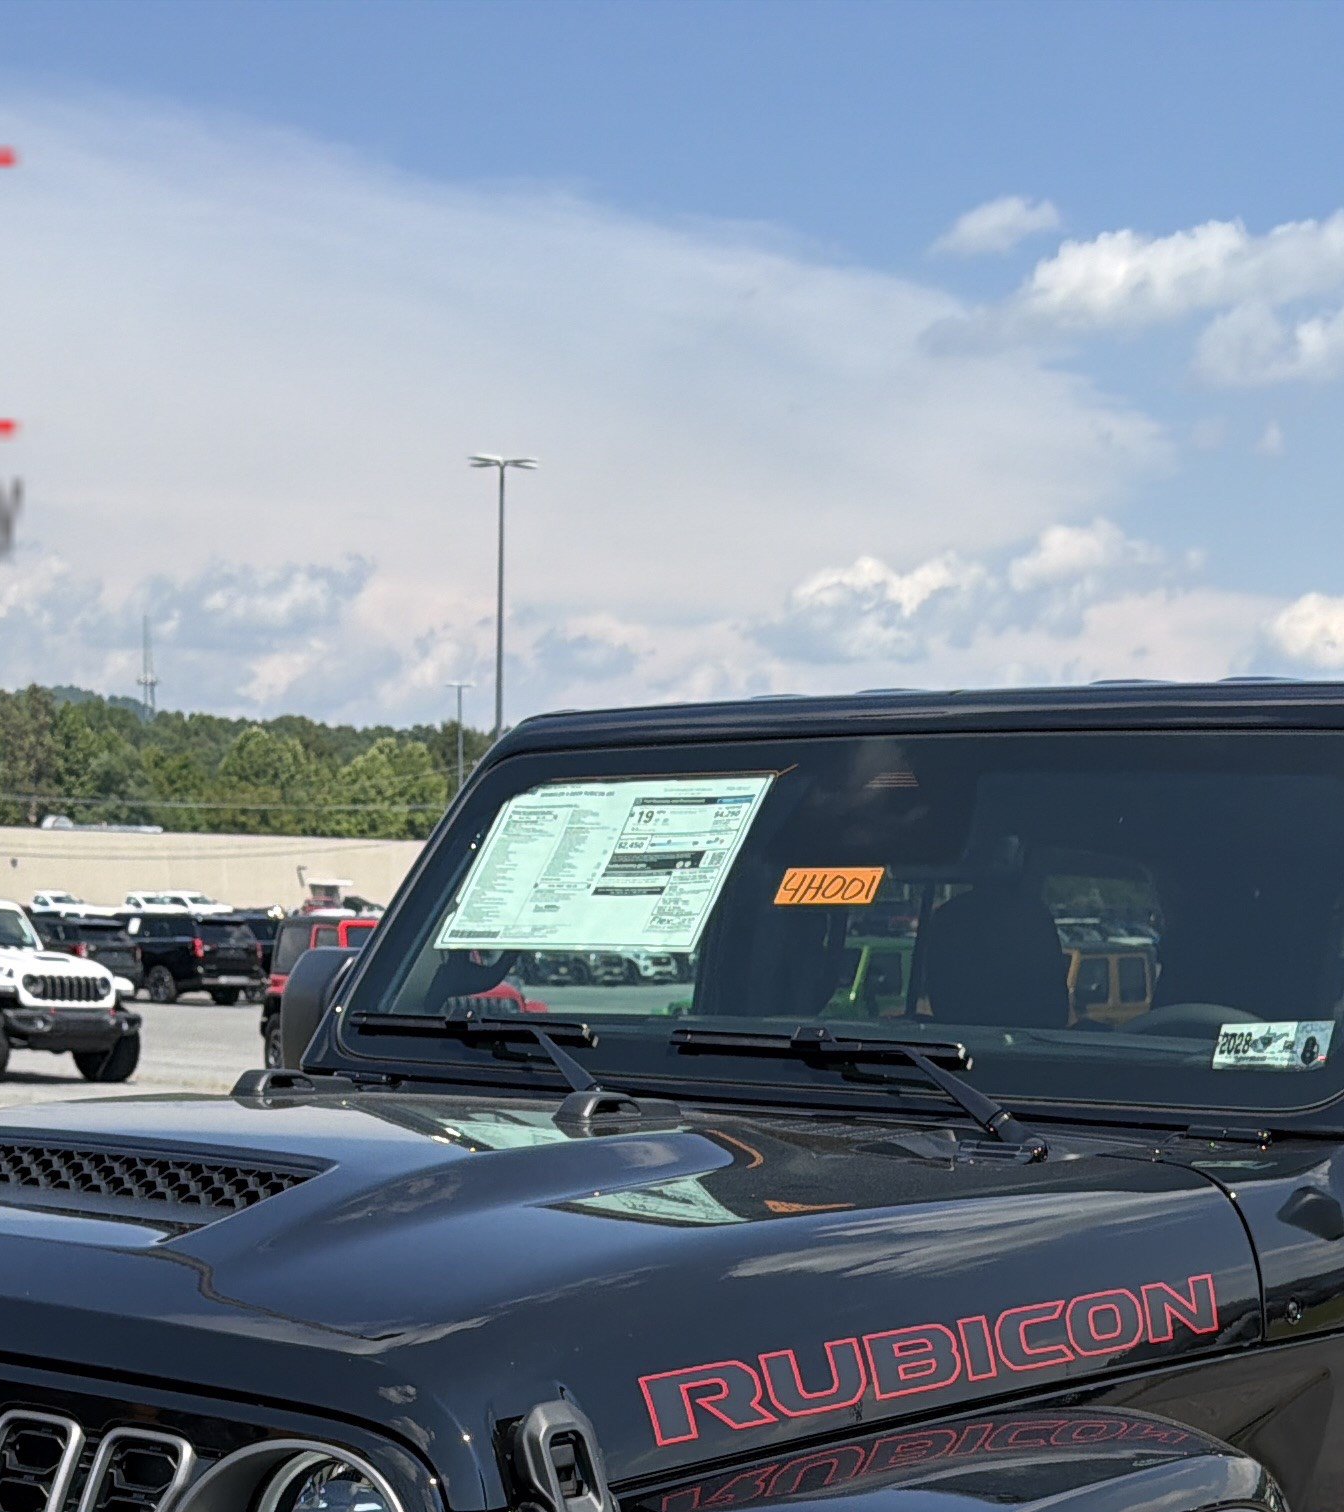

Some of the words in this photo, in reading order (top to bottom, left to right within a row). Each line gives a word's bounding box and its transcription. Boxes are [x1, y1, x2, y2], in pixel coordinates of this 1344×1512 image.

[637, 809, 655, 824] 19
[1218, 1031, 1253, 1055] 2028
[638, 1273, 1219, 1447] RUBICON
